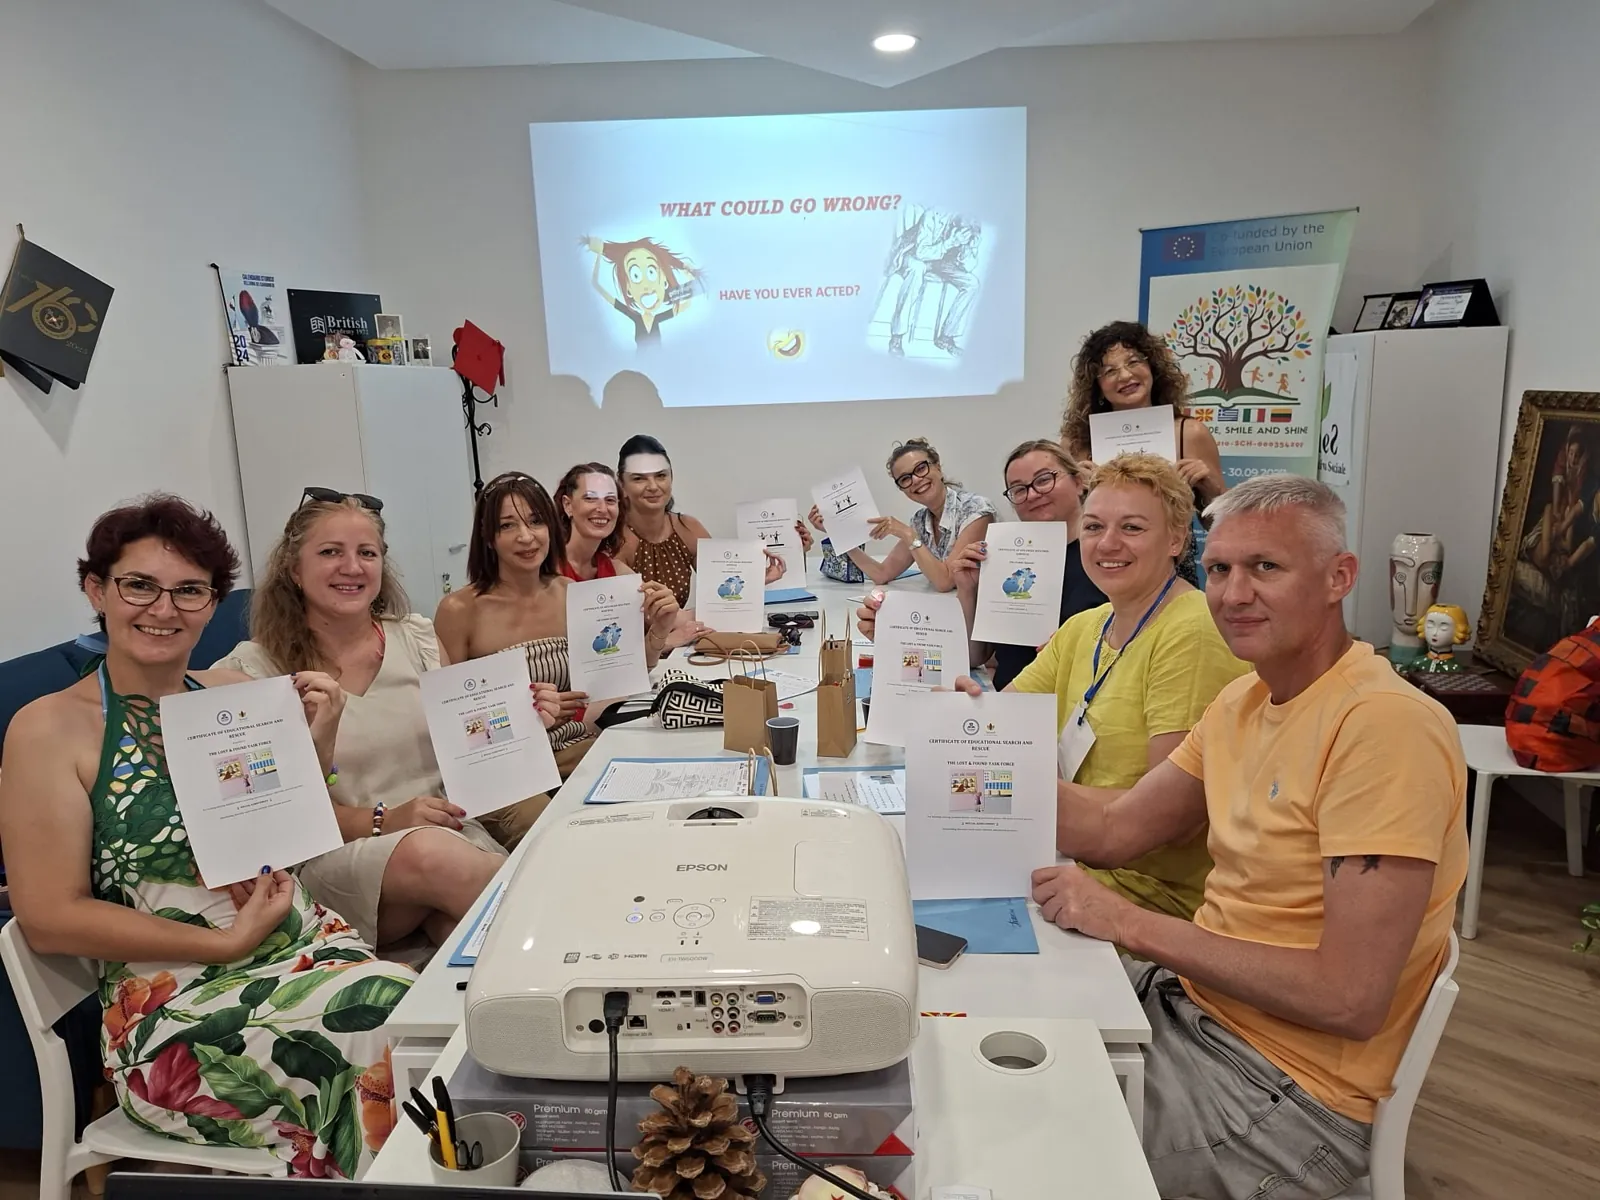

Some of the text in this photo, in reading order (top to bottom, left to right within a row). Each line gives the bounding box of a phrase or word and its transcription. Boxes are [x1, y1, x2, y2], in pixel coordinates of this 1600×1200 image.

[660, 194, 902, 217] WHAT COULD GO WRONG?
[1282, 225, 1298, 238] by
[1303, 224, 1325, 234] the
[1211, 240, 1313, 257] European Union
[719, 285, 861, 300] HAVE YOU EVER ACTED?
[327, 315, 368, 329] British
[233, 335, 247, 348] 20
[236, 349, 250, 362] 24
[1225, 426, 1253, 434] SMILE
[1257, 426, 1281, 434] AND
[1284, 426, 1309, 435] SHINE
[676, 863, 728, 872] EPSON
[533, 1103, 581, 1114] Premium
[771, 1109, 820, 1118] Premium
